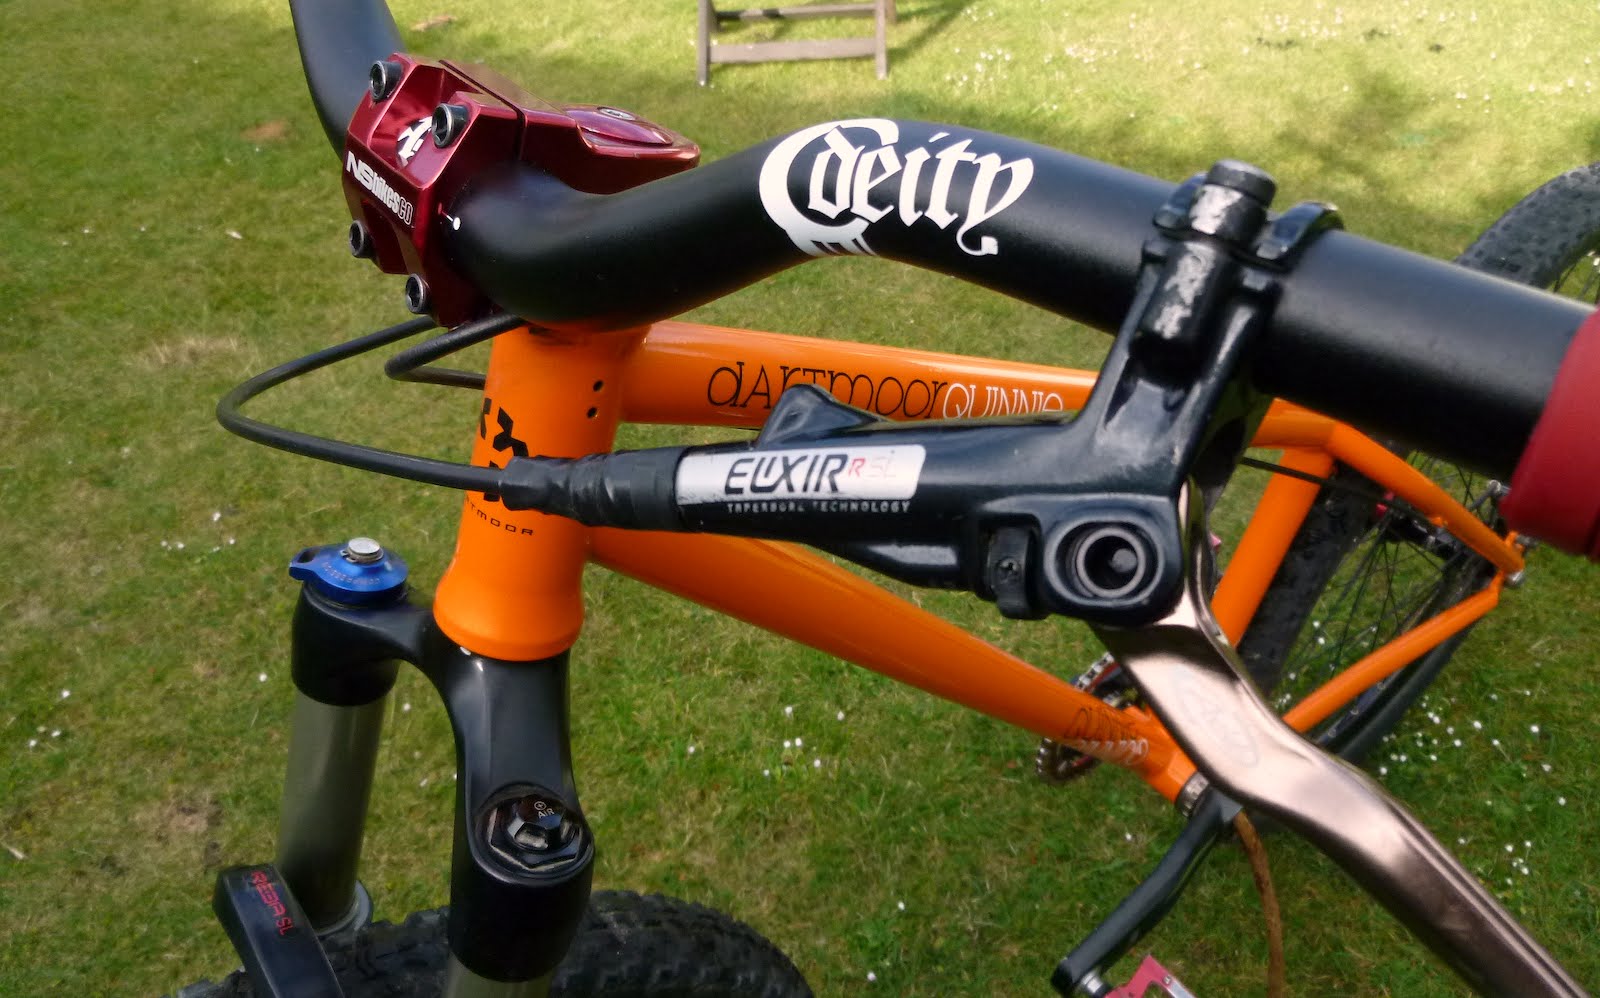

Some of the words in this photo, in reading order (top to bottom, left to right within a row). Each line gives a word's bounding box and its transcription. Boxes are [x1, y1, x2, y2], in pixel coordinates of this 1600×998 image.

[725, 453, 849, 495] ELIXIR
[848, 458, 866, 478] R
[538, 808, 555, 819] AIR
[251, 870, 287, 917] REBA
[275, 916, 294, 936] SL
